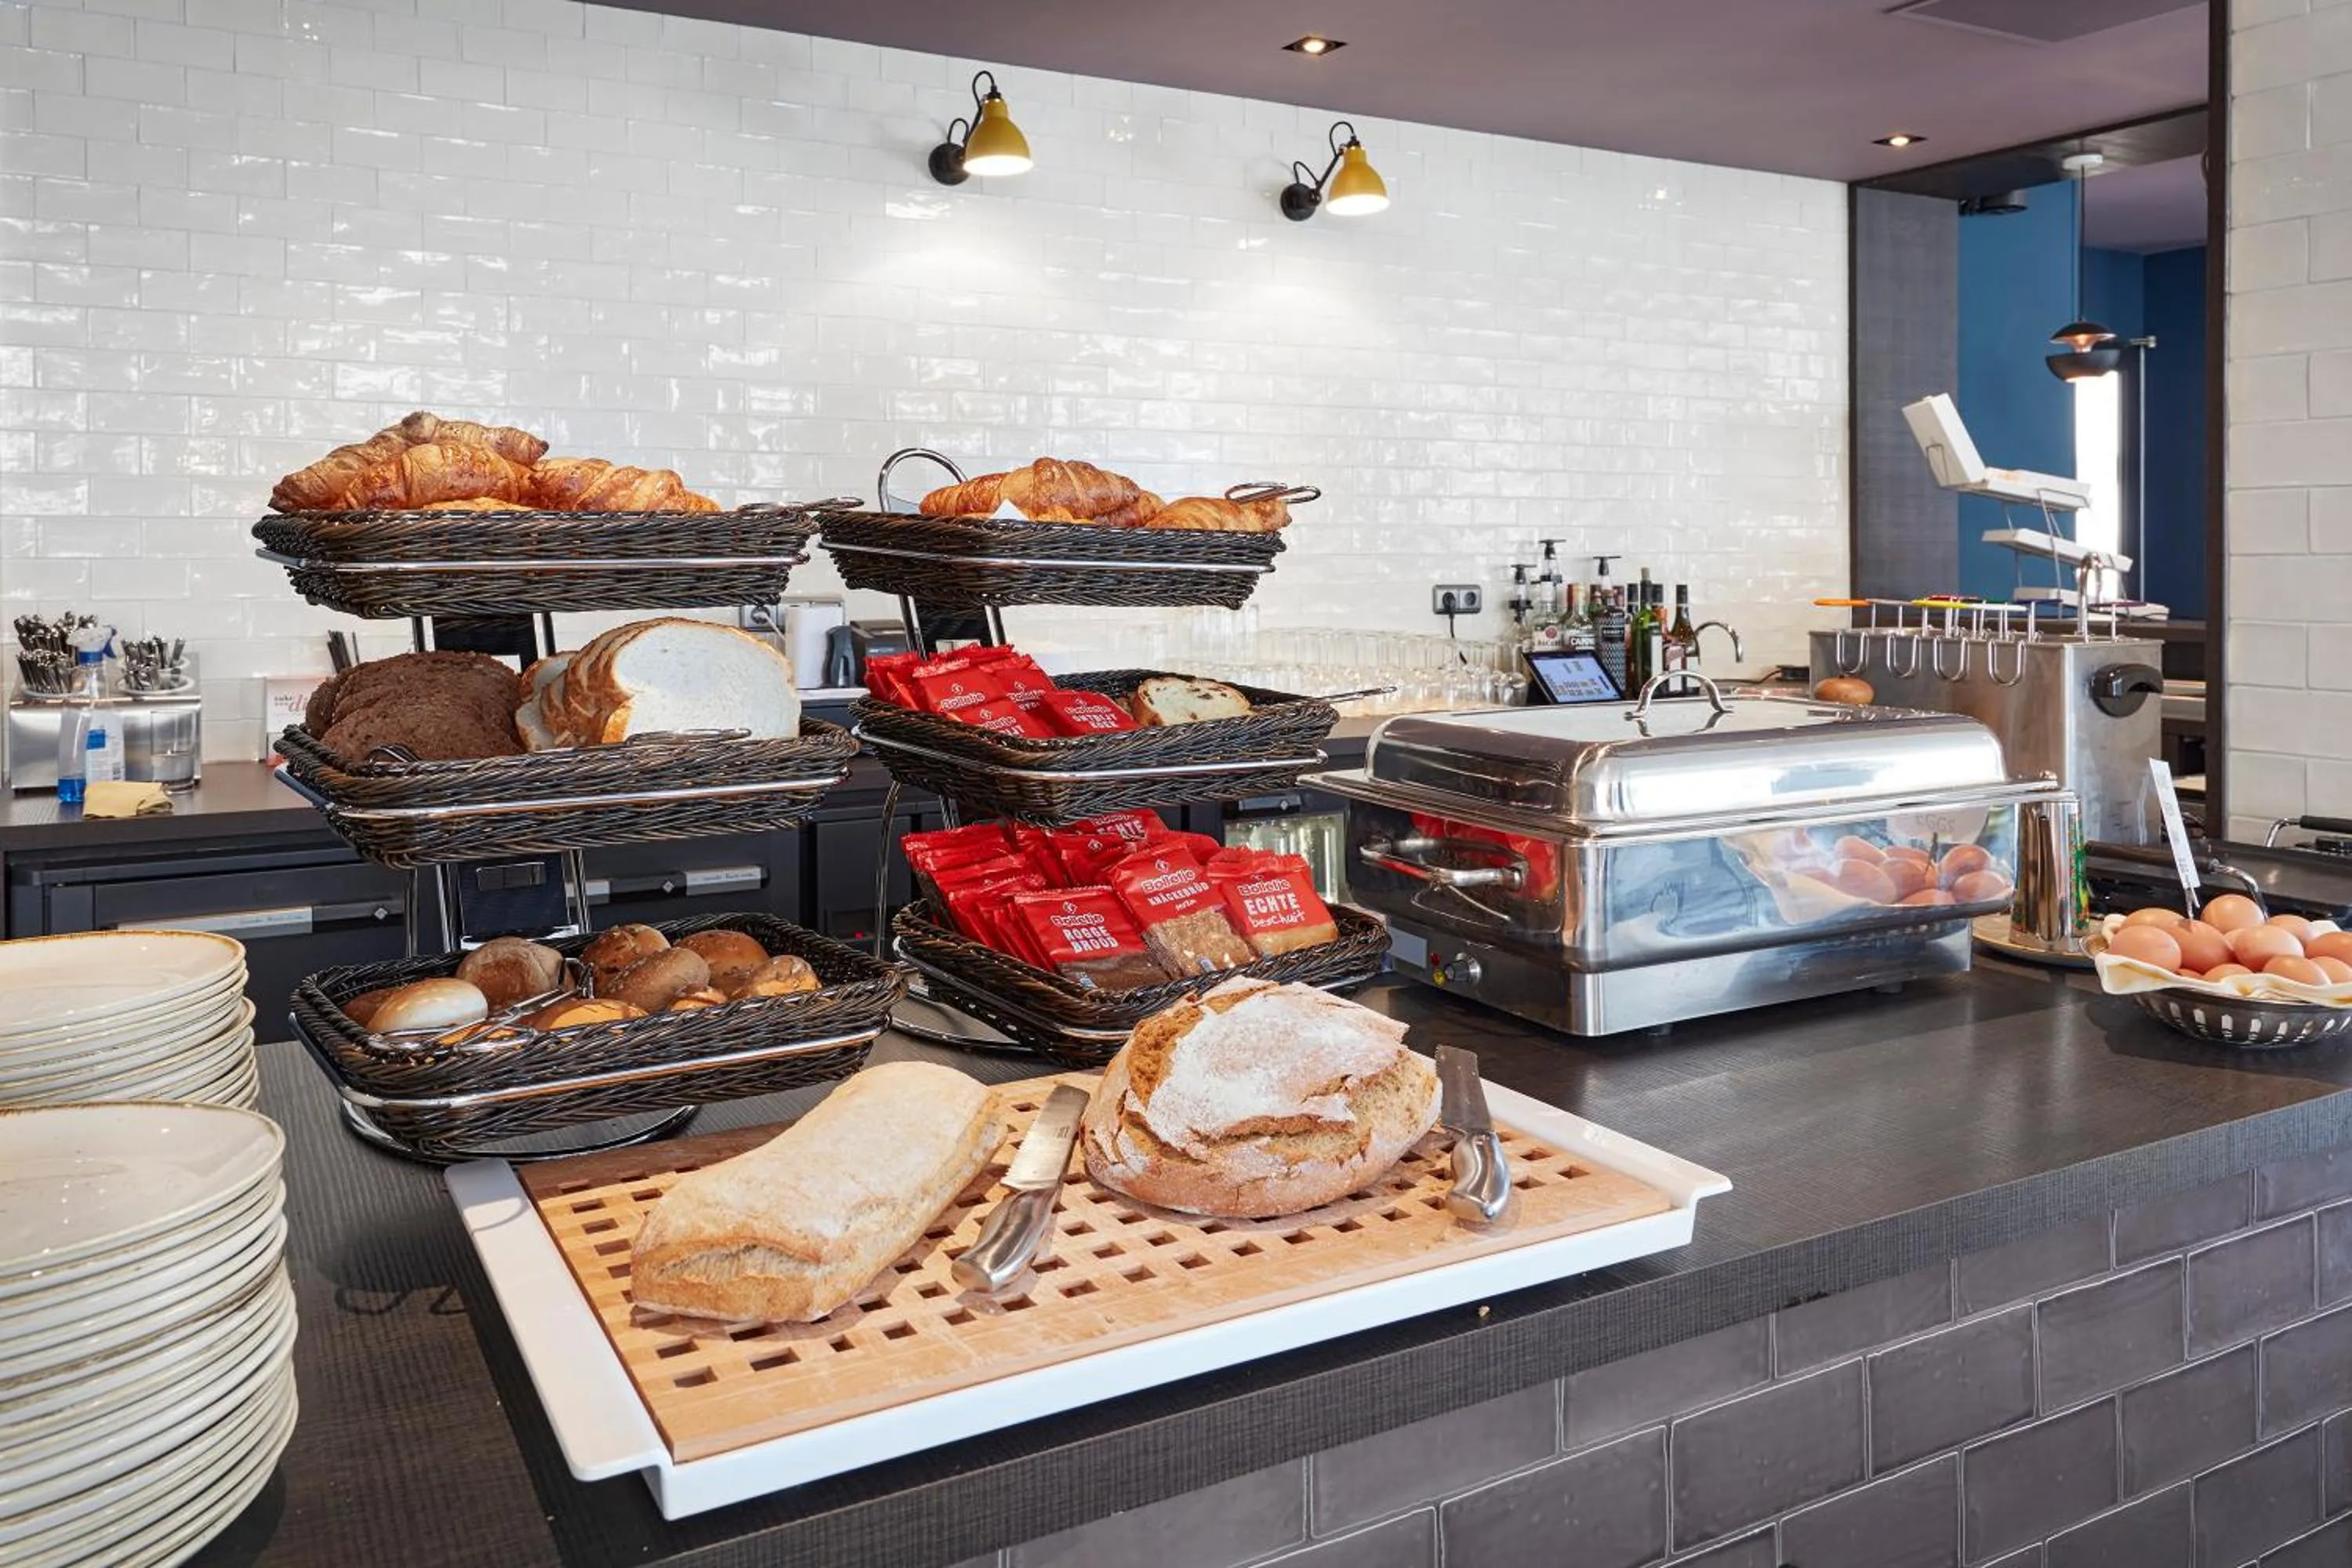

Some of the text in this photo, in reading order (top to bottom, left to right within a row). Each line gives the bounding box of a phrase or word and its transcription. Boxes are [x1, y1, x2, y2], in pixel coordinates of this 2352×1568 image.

[1142, 868, 1196, 894] Bolletje
[1236, 878, 1291, 896] Bolletje
[1243, 892, 1301, 916] ECHTE
[1050, 912, 1105, 927] Bolletje
[1062, 926, 1111, 942] ROGGE
[1070, 937, 1119, 954] BROOD
